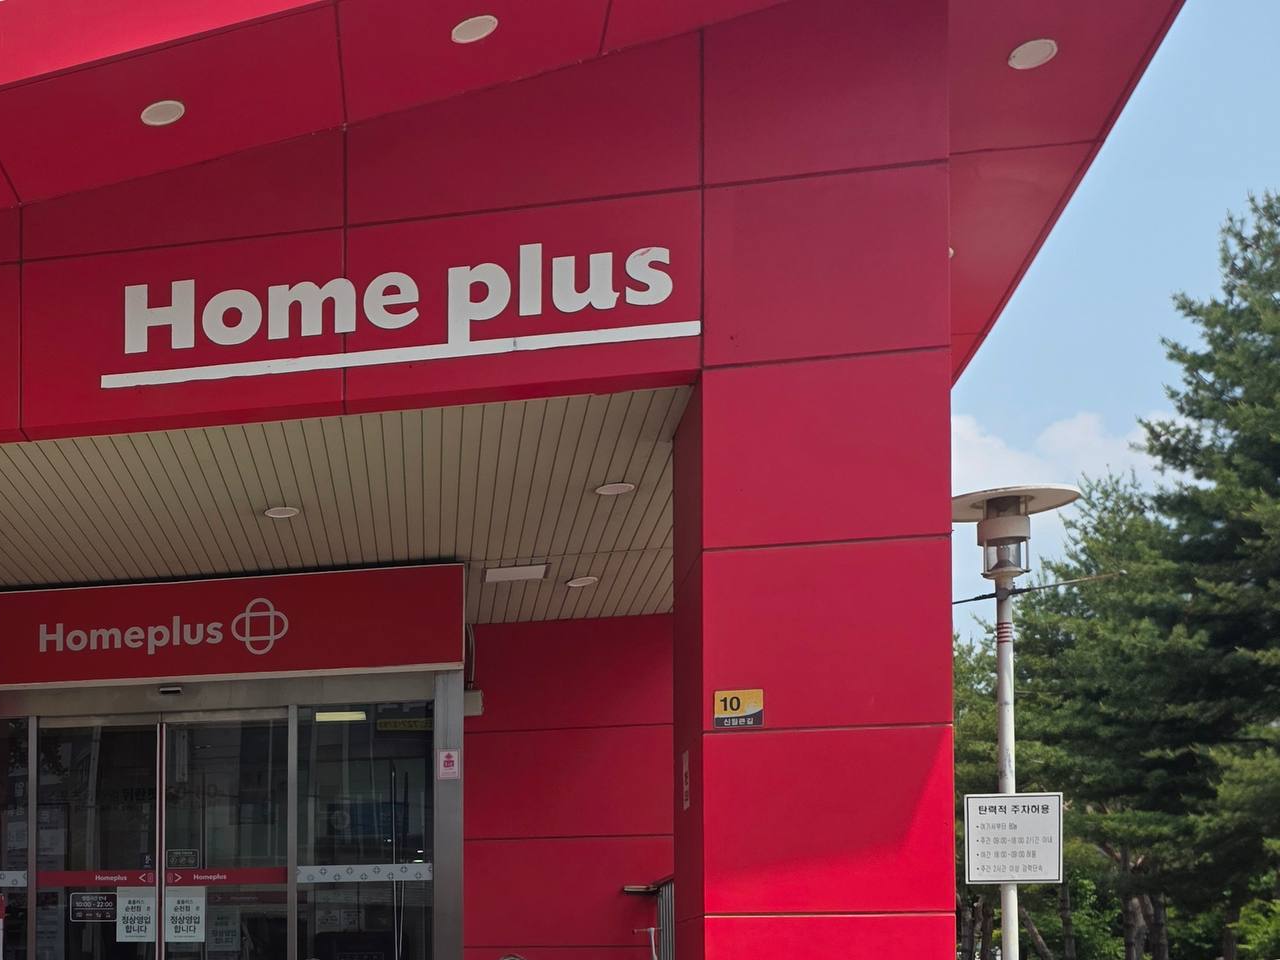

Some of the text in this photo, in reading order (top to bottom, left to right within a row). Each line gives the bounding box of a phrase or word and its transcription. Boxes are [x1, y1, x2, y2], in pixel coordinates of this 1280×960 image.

[124, 243, 674, 355] Home plus
[38, 615, 223, 655] Homeplus
[720, 696, 741, 711] 10
[1011, 804, 1049, 814] 주차허용
[95, 874, 127, 882] Homeplus
[193, 873, 227, 881] Homeplus
[122, 916, 151, 924] 정상영업
[170, 916, 200, 924] 정상영업
[125, 925, 147, 934] 합니다
[174, 925, 196, 934] 합니다
